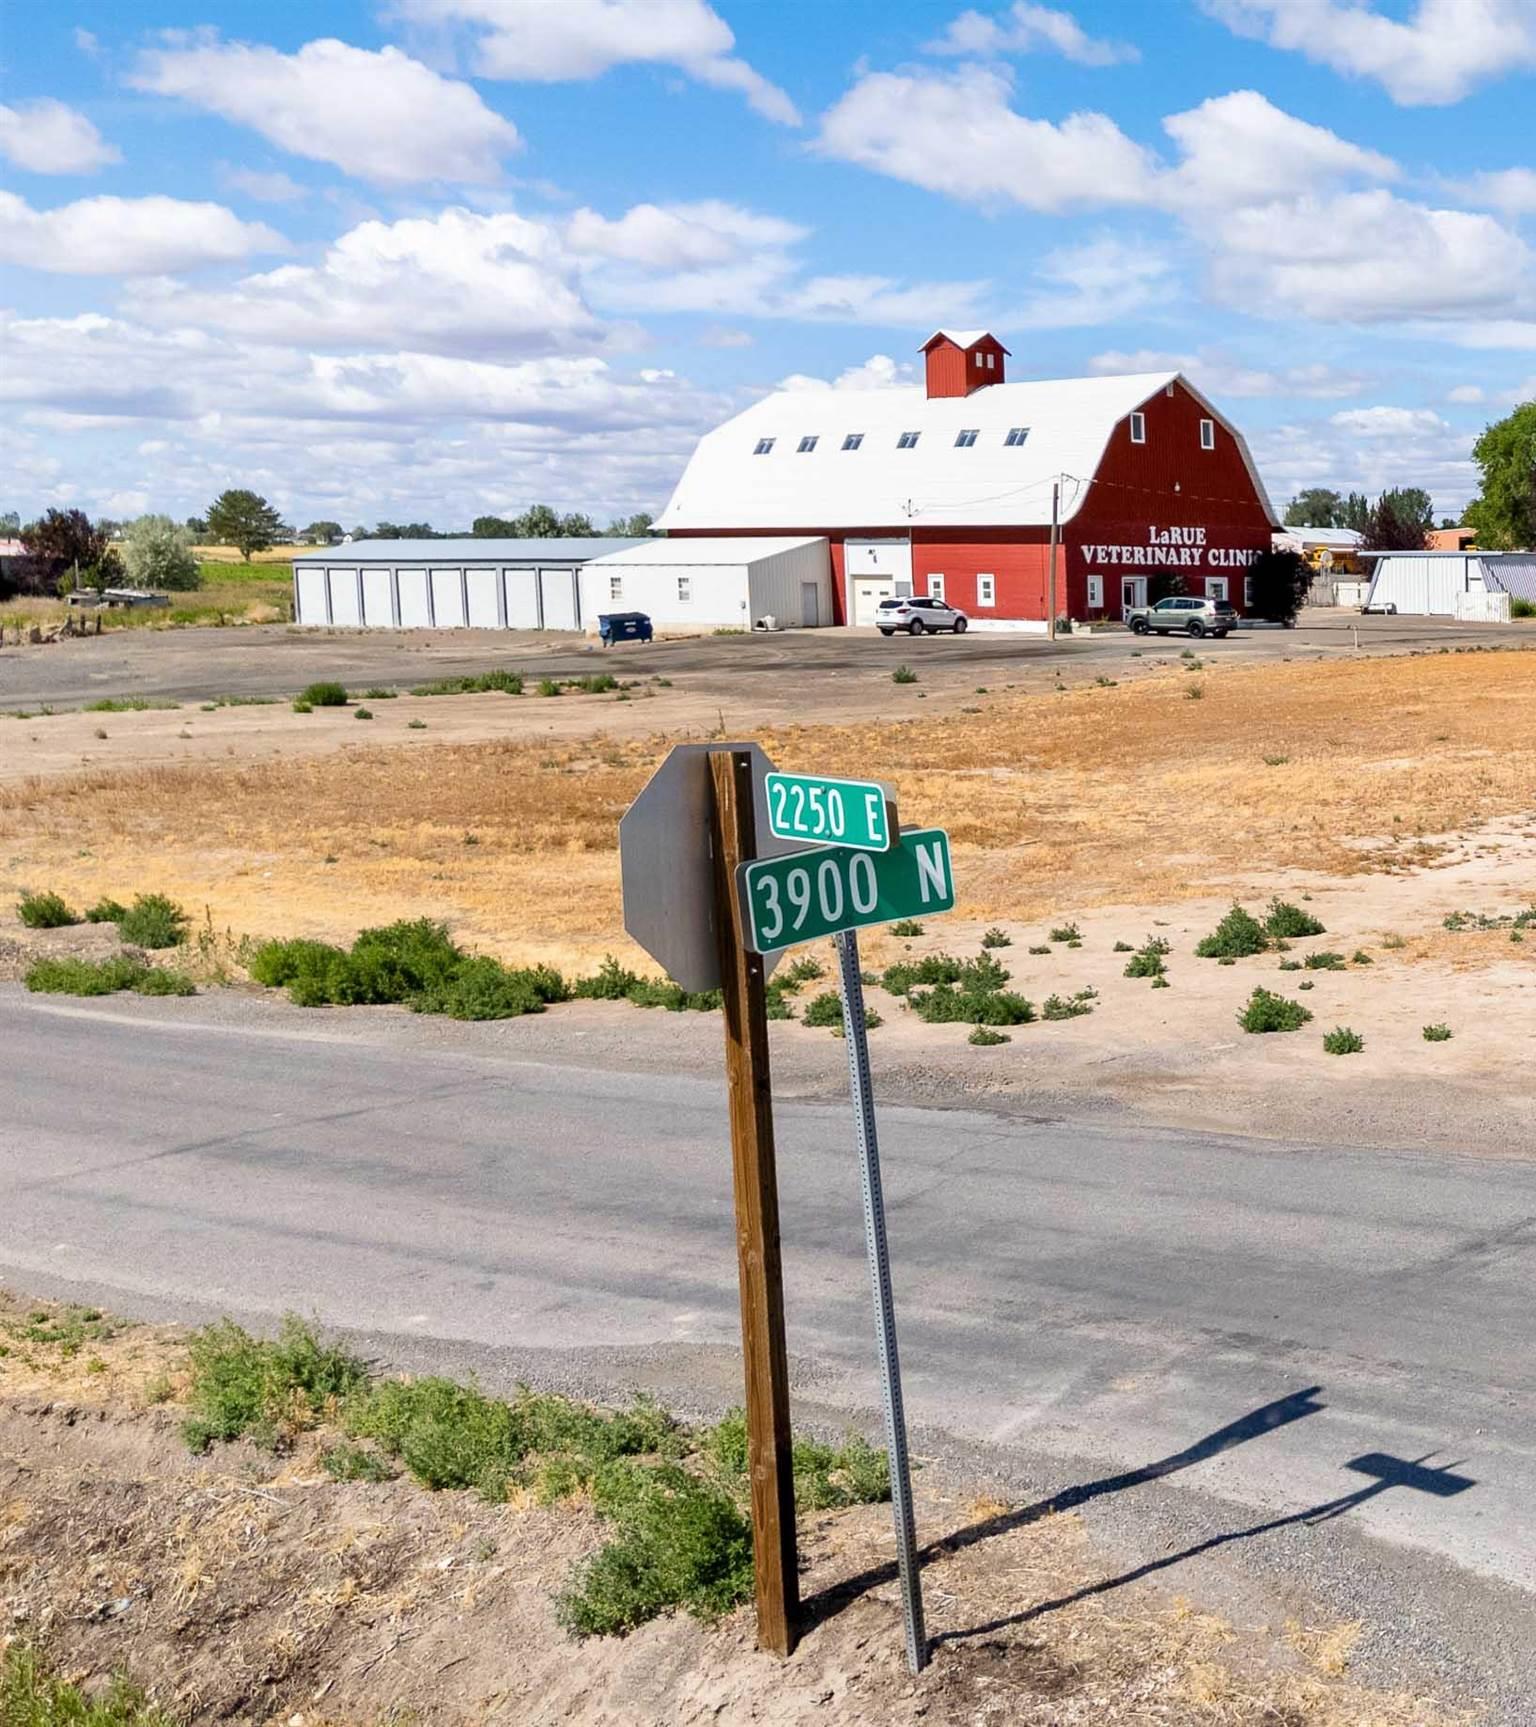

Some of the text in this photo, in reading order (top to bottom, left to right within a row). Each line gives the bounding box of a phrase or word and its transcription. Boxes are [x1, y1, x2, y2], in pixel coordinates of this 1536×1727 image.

[1149, 525, 1207, 545] LaRUE
[1081, 545, 1203, 566] VETERINARY
[772, 782, 883, 841] 2250 E
[756, 841, 948, 939] 3900 N
